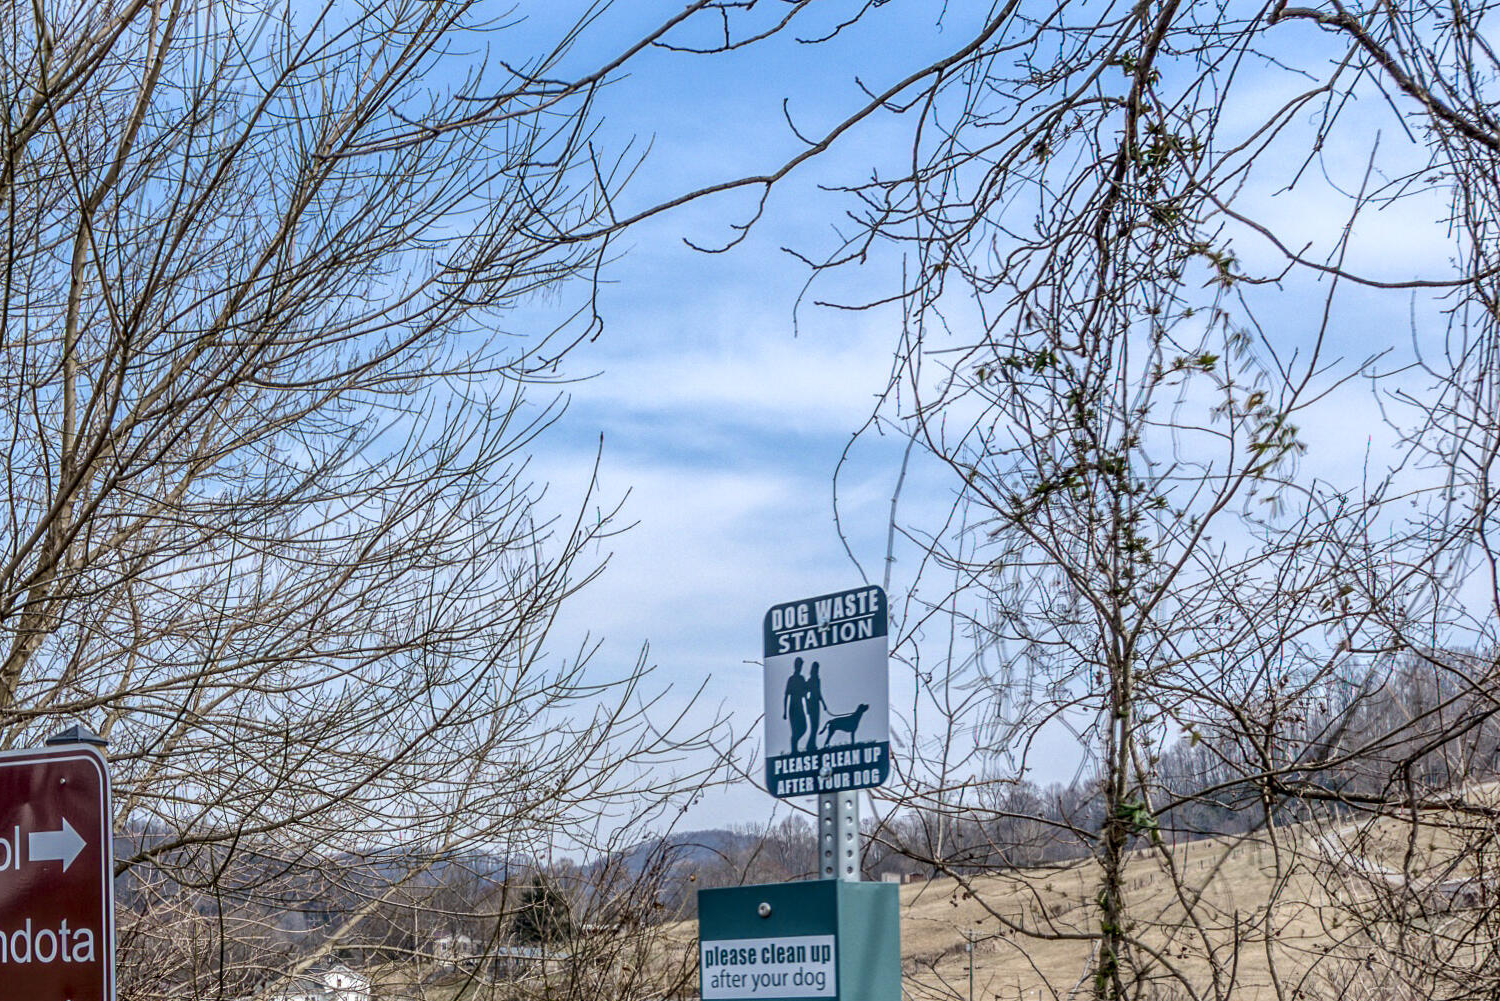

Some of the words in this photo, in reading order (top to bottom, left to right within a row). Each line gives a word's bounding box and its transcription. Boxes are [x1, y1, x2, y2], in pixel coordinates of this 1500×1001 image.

[772, 604, 809, 631] DOG
[815, 589, 879, 622] WASTE
[778, 619, 873, 653] STATION
[775, 755, 819, 775] PLEASE
[822, 749, 860, 770] CLEAN
[864, 747, 881, 763] UP
[777, 777, 814, 795] AFTER
[817, 772, 850, 790] YOUR
[853, 769, 880, 786] DOG
[705, 946, 757, 968] please
[761, 943, 806, 964] clean
[811, 945, 831, 964] up
[711, 969, 747, 988] after
[751, 972, 789, 992] your
[793, 966, 826, 991] dog
